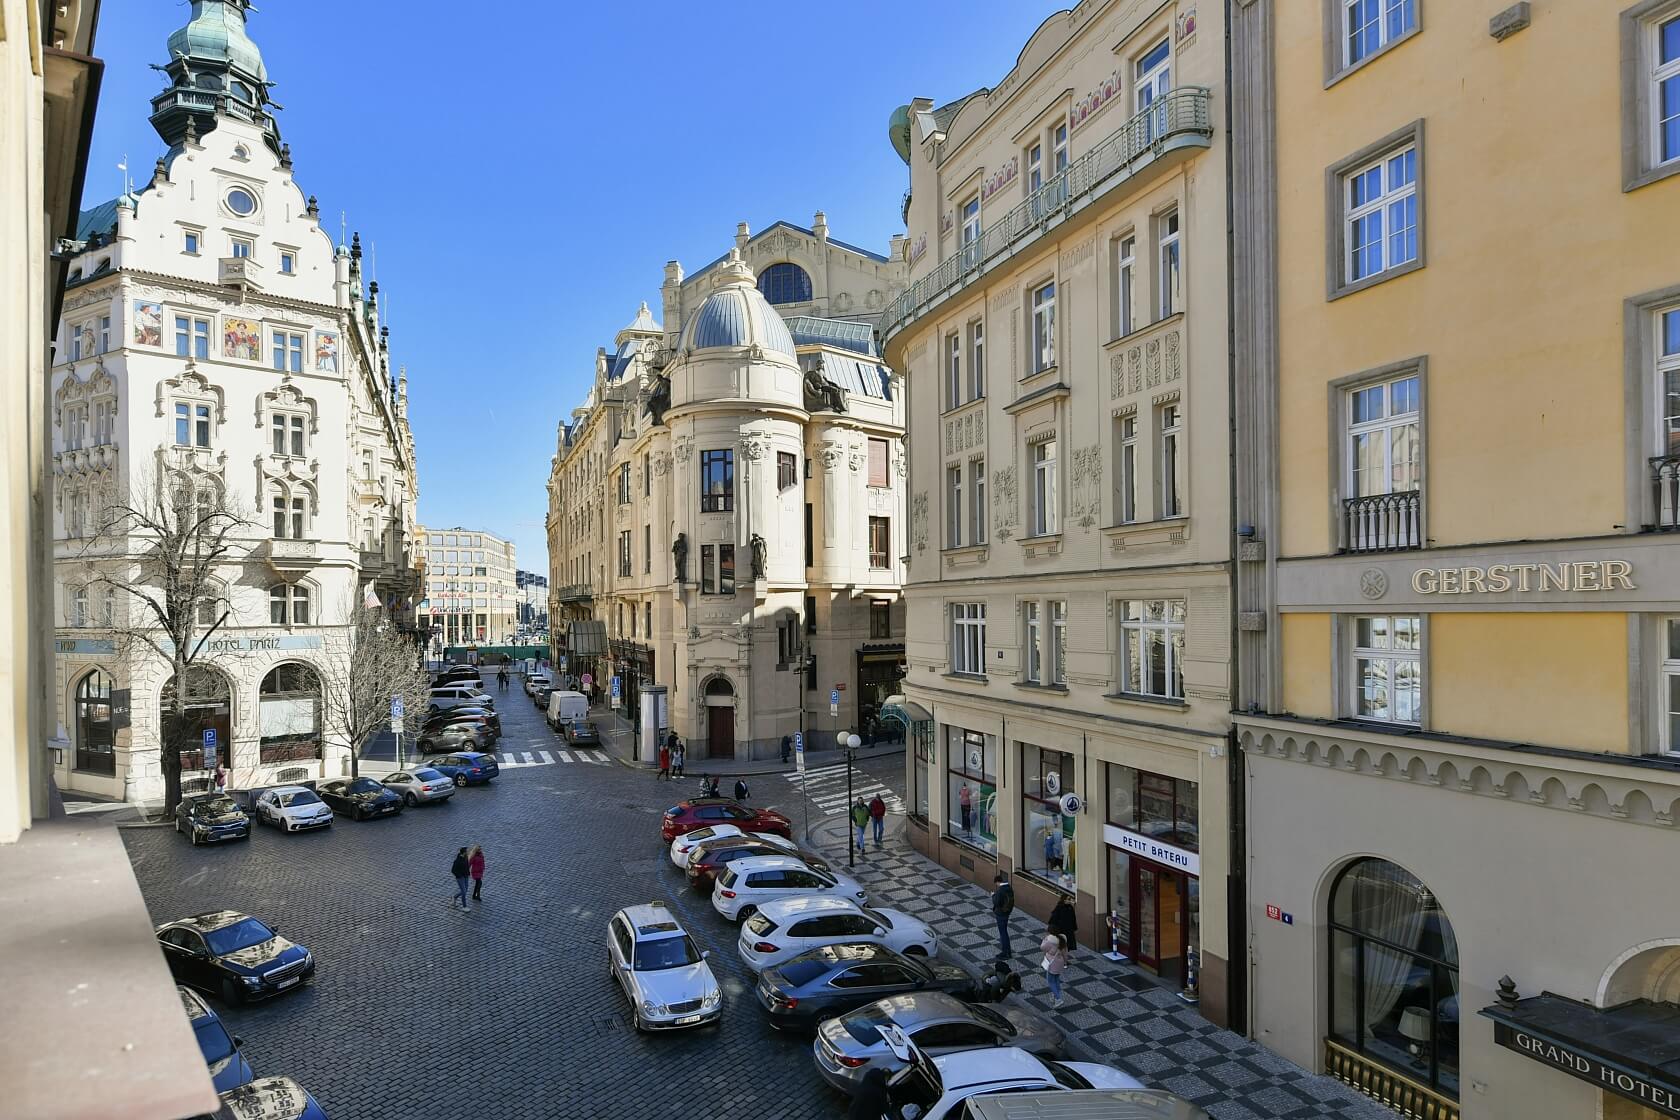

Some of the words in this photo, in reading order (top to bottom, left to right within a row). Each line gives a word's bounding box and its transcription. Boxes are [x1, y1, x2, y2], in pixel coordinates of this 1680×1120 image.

[1411, 560, 1637, 594] GERSTNER
[207, 639, 244, 652] HOTEL
[1123, 836, 1147, 852] PETIT
[1151, 846, 1188, 866] BATEAU
[1516, 1033, 1590, 1073] GRAND
[1601, 1066, 1680, 1111] HOTEL
